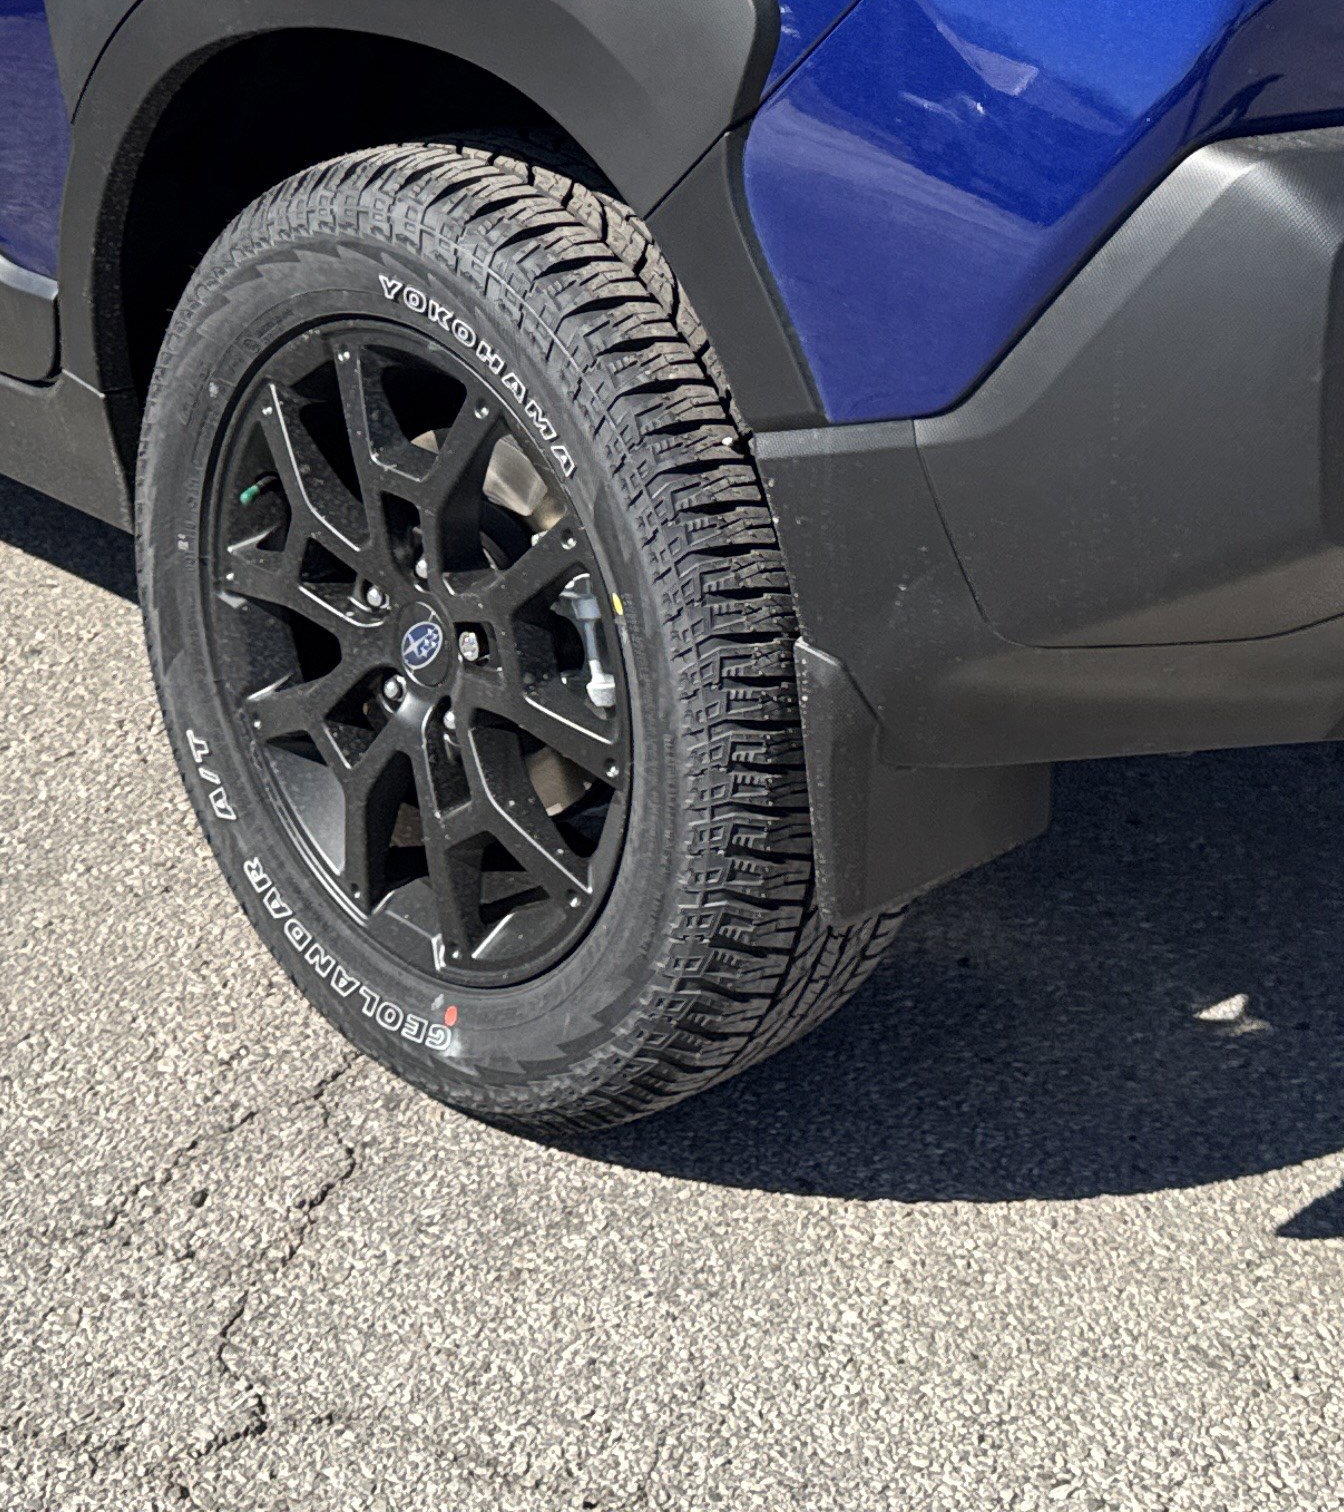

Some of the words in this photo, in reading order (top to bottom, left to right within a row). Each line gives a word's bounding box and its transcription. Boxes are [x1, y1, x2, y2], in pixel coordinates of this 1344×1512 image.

[378, 273, 576, 478] YOKOHAMA
[186, 728, 238, 821] A/T
[242, 856, 453, 1051] GEOLANDAR
